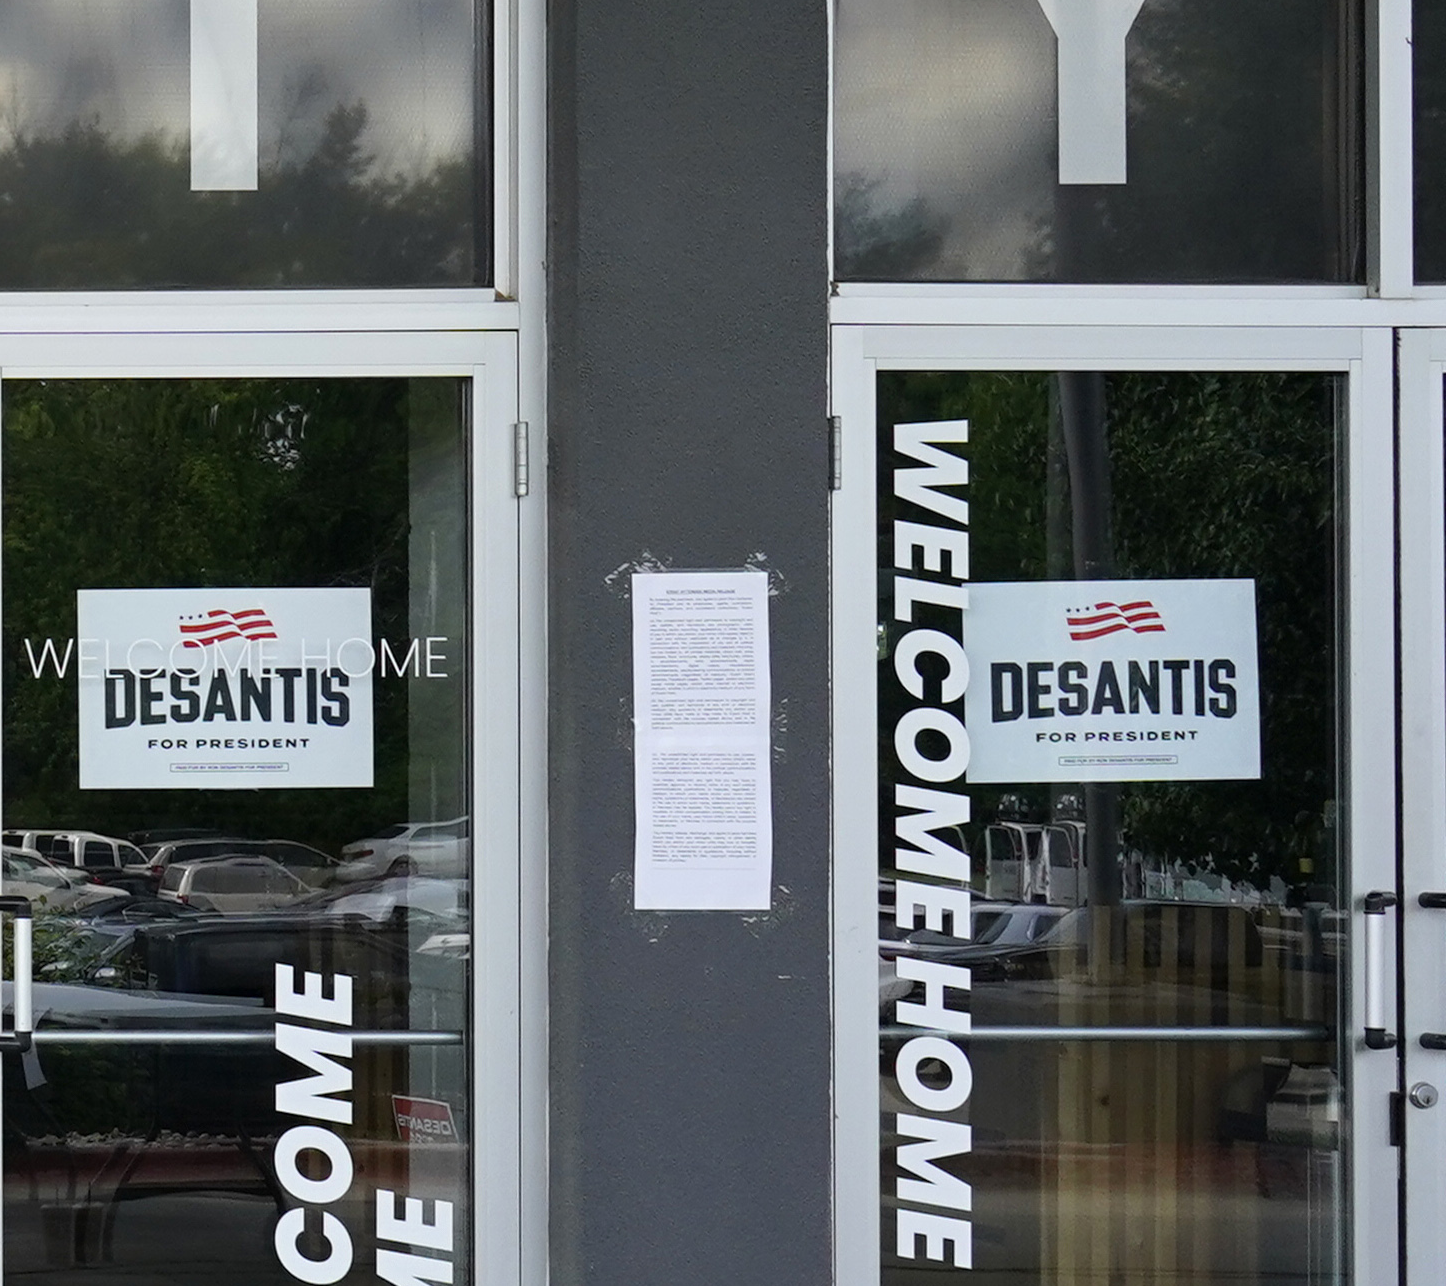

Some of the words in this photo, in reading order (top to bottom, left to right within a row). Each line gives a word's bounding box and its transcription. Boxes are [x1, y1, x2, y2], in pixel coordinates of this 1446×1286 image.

[23, 637, 278, 680] WELCOME
[301, 636, 450, 680] HOME
[893, 419, 971, 941] WELCOME
[104, 667, 350, 730] DESANTIS
[990, 658, 1237, 724] DESANTIS
[148, 739, 189, 750] FOR
[196, 738, 310, 749] PRESIDENT
[1036, 732, 1077, 743] FOR
[1084, 730, 1198, 742] PRESIDENT
[895, 956, 973, 1270] HOME
